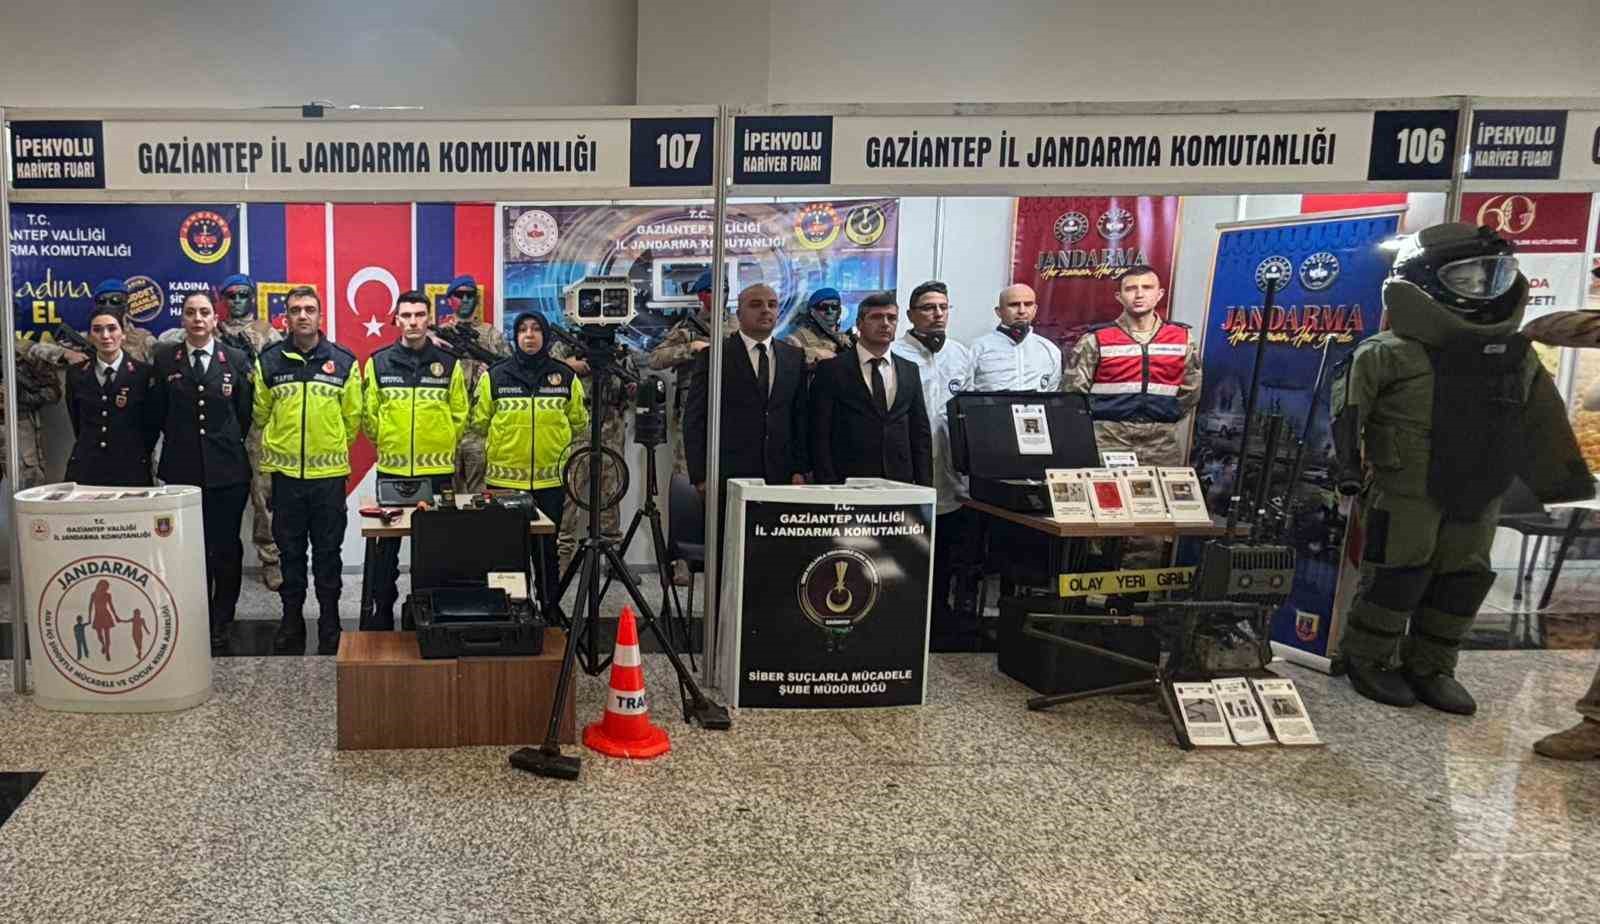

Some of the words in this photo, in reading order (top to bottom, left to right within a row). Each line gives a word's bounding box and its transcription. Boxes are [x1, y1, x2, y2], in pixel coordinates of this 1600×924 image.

[744, 129, 823, 151] İPEKYOLU
[1476, 122, 1556, 146] İPEKYOLU
[16, 135, 94, 158] İPEKYOLU
[138, 136, 264, 174] GAZİANTEP
[271, 136, 292, 173] İL
[298, 142, 430, 173] JANDARMA
[439, 134, 597, 173] KOMUTANLIĞI
[656, 133, 701, 169] 107
[865, 130, 992, 168] GAZİANTEP
[999, 130, 1020, 168] İL
[1026, 136, 1161, 168] JANDARMA
[1170, 126, 1336, 168] KOMUTANLIĞI
[1397, 128, 1446, 164] 106
[743, 153, 788, 172] KARİYER
[790, 155, 821, 172] FUARI
[1474, 148, 1520, 167] KARİYER
[1521, 150, 1553, 167] FUARI
[16, 160, 64, 178] KARİYER
[64, 161, 95, 178] FUARI
[26, 214, 50, 226] T.C.
[689, 210, 711, 220] T.C.
[51, 228, 106, 241] VALİLİĞİ
[636, 223, 708, 235] GAZİANTEP
[41, 244, 132, 257] KOMUTANLIĞI
[630, 239, 697, 250] JANDARMA
[1034, 248, 1148, 270] JANDARMA
[168, 281, 210, 290] KADINA
[1530, 278, 1550, 288] DA
[32, 301, 62, 324] EL
[1221, 304, 1364, 331] JANDARMA
[780, 512, 852, 524] GAZİANTEP
[856, 510, 904, 523] VALİLİĞİ
[755, 526, 767, 536] İL
[770, 526, 840, 537] JANDARMA
[844, 524, 924, 537] KOMUTANLIĞI
[57, 561, 150, 590] JANDARMA
[1070, 576, 1104, 592] OLAY
[1156, 570, 1196, 586] GİRİL
[748, 670, 784, 682] SİBER
[787, 671, 848, 684] SUÇLARLA
[852, 669, 912, 681] MÜCADELE
[778, 684, 810, 696] ŞUBE
[814, 682, 886, 695] MÜDÜRLÜĞÜ
[616, 695, 646, 709] TRA
